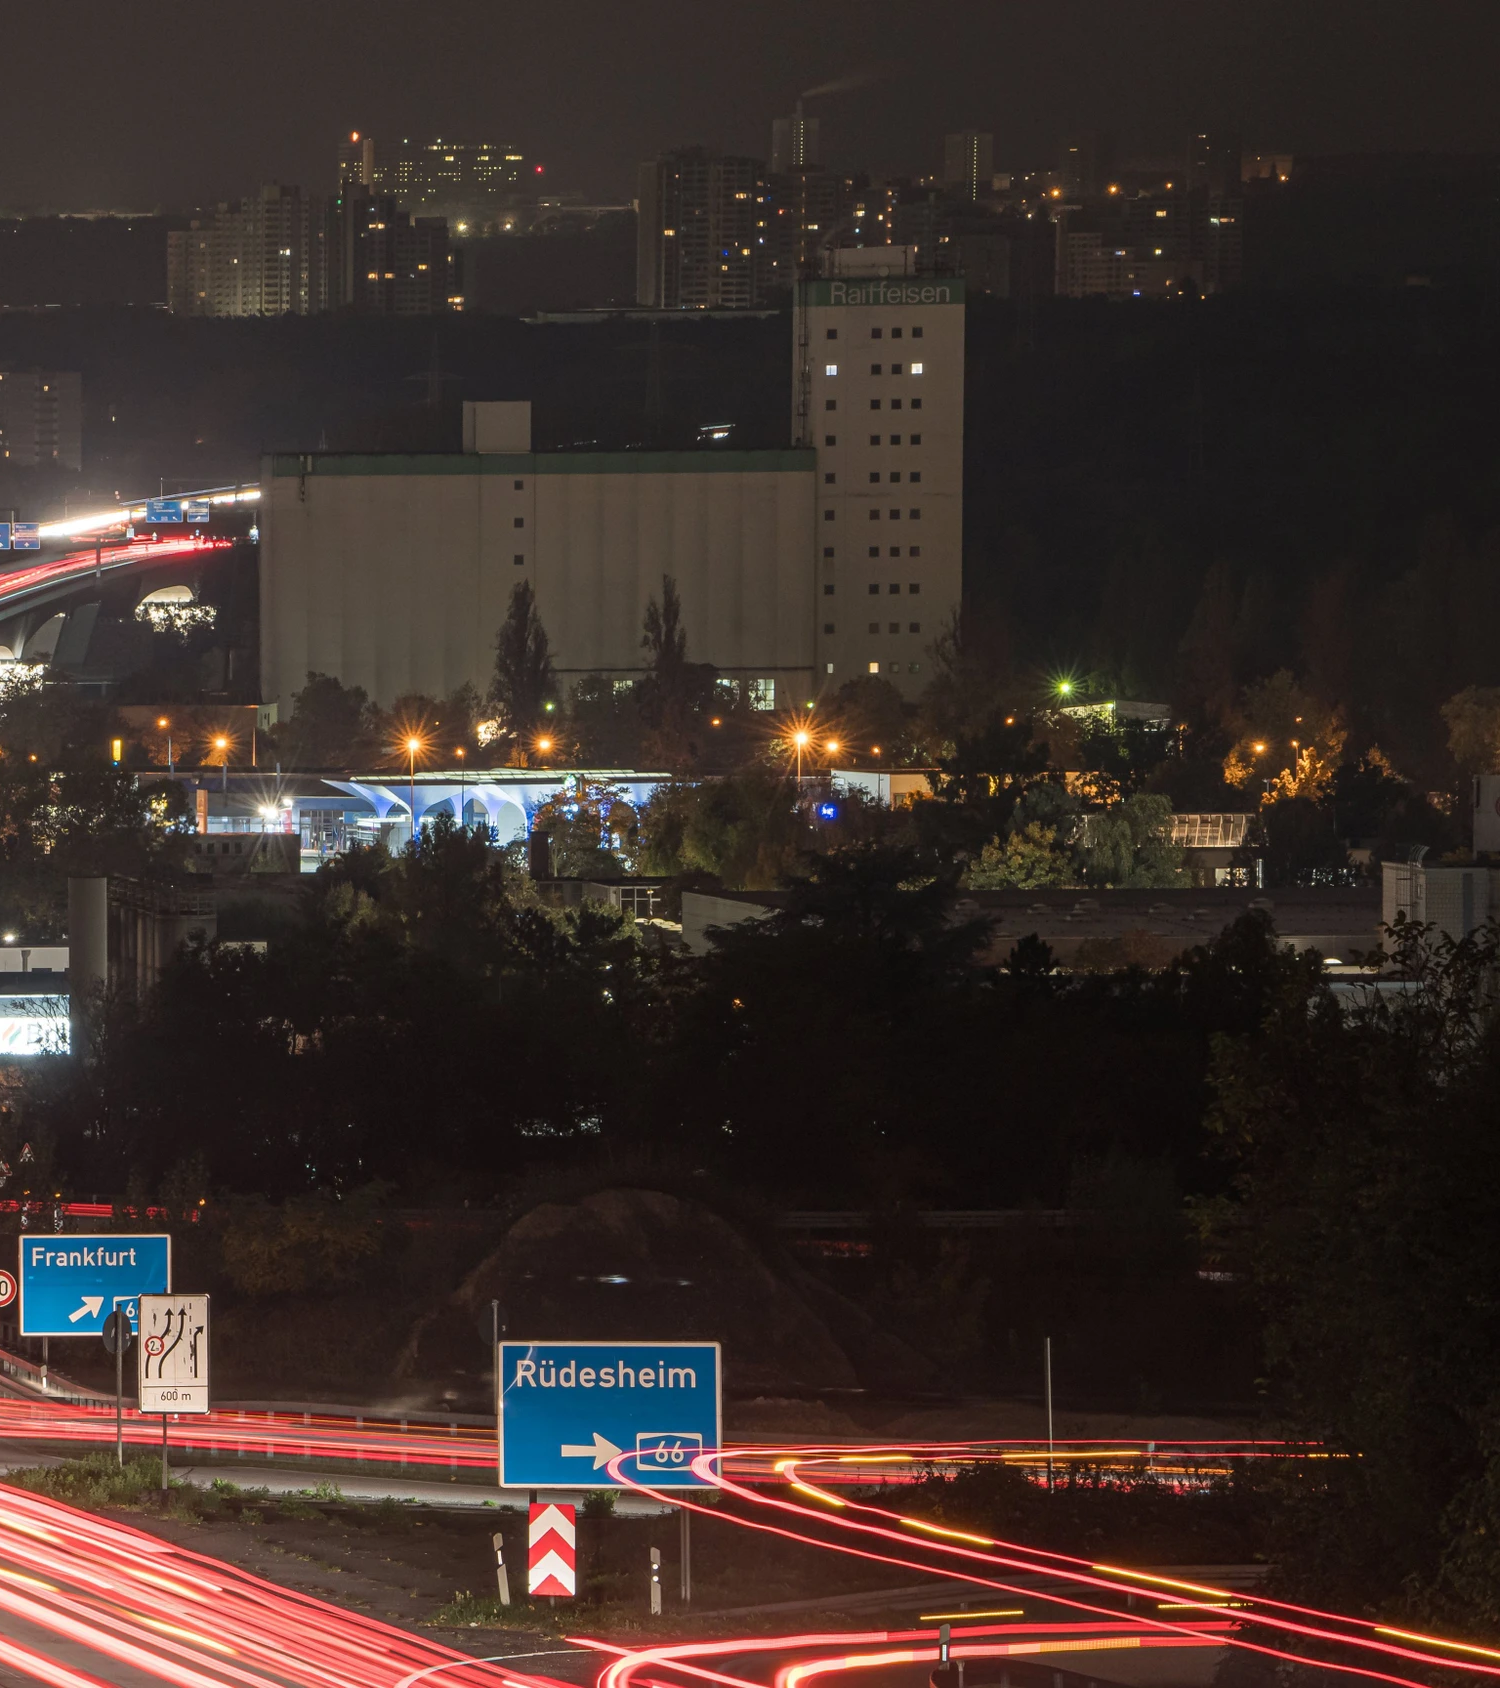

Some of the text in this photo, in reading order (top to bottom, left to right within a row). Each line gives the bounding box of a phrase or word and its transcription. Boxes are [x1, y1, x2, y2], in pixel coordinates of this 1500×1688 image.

[830, 281, 950, 304] Raiffeisen
[32, 1247, 136, 1267] Frankfurt
[126, 1301, 138, 1317] 6
[516, 1360, 696, 1388] Rüdesheim
[160, 1391, 192, 1401] 600 m
[655, 1440, 684, 1463] 66
